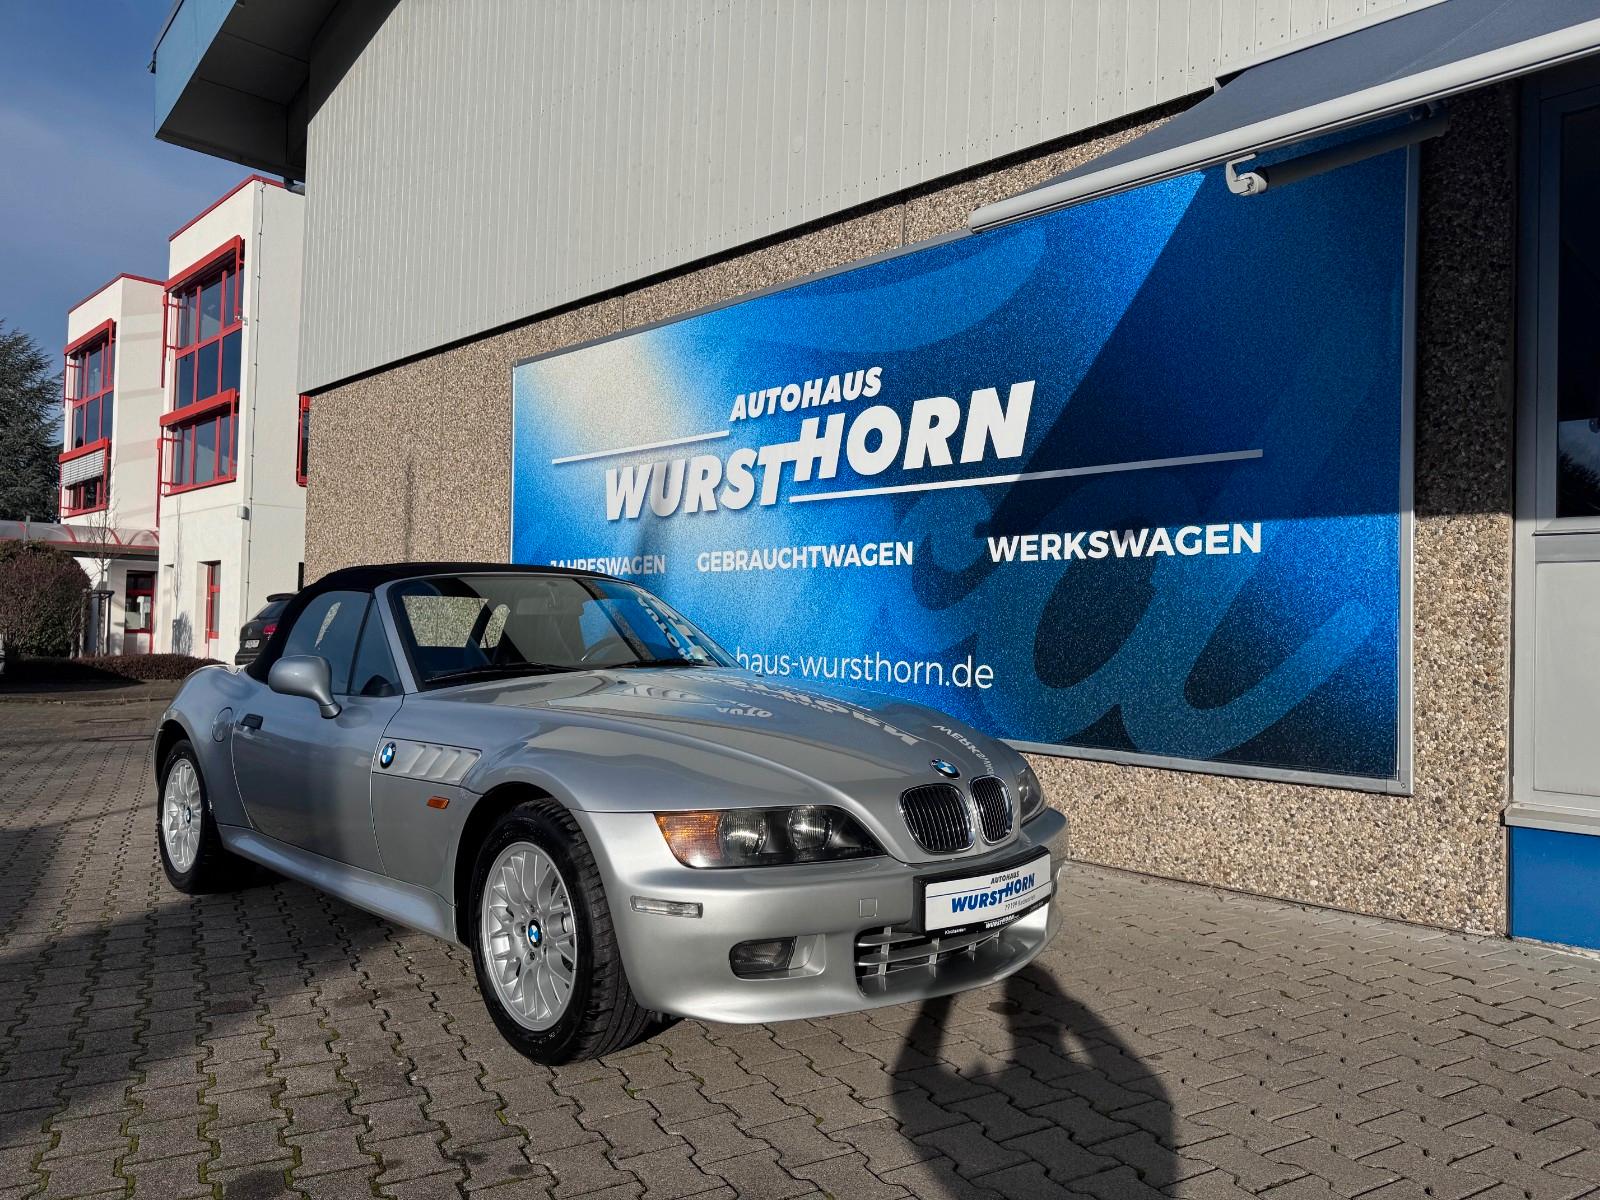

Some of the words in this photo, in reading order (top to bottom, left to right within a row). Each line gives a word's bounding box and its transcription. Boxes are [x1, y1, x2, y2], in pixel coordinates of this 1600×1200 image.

[730, 366, 882, 422] AUTOHAUS
[605, 380, 1036, 521] WURSTHORN
[697, 541, 913, 573] GEBRAUCHTWAGEN
[987, 522, 1262, 562] WERKSWAGEN
[951, 873, 1035, 913] WURSTHORN
[990, 870, 1020, 884] AUTOHAUS
